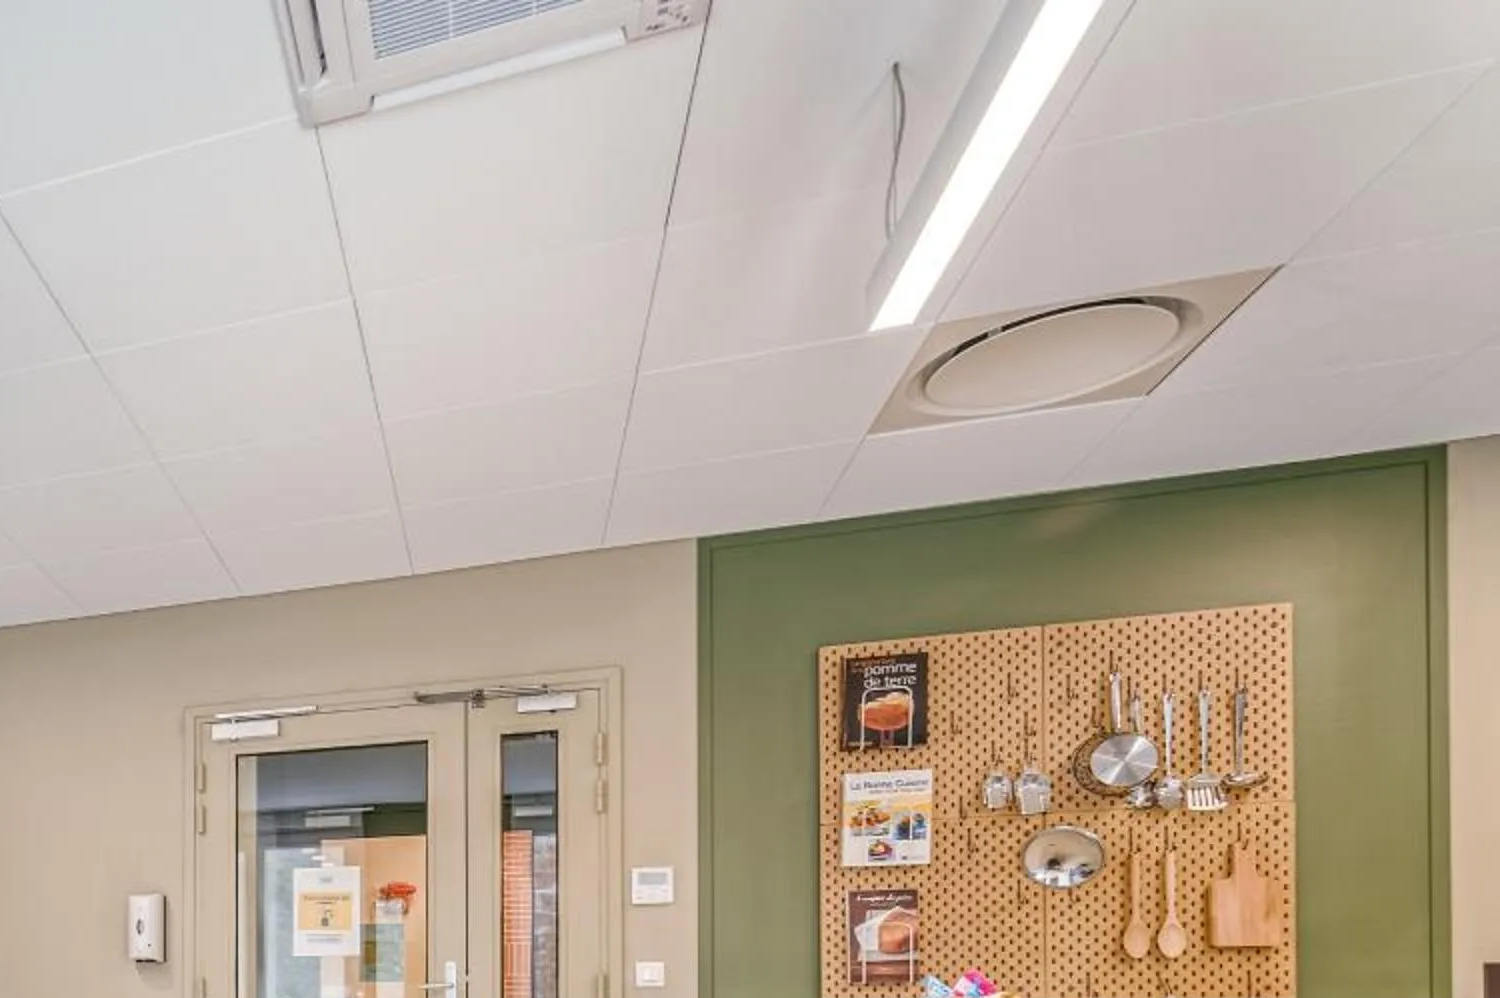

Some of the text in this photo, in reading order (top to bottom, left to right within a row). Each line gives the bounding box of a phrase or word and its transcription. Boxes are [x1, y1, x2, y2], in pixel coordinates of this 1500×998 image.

[863, 663, 917, 678] pomme
[863, 675, 917, 688] de terre
